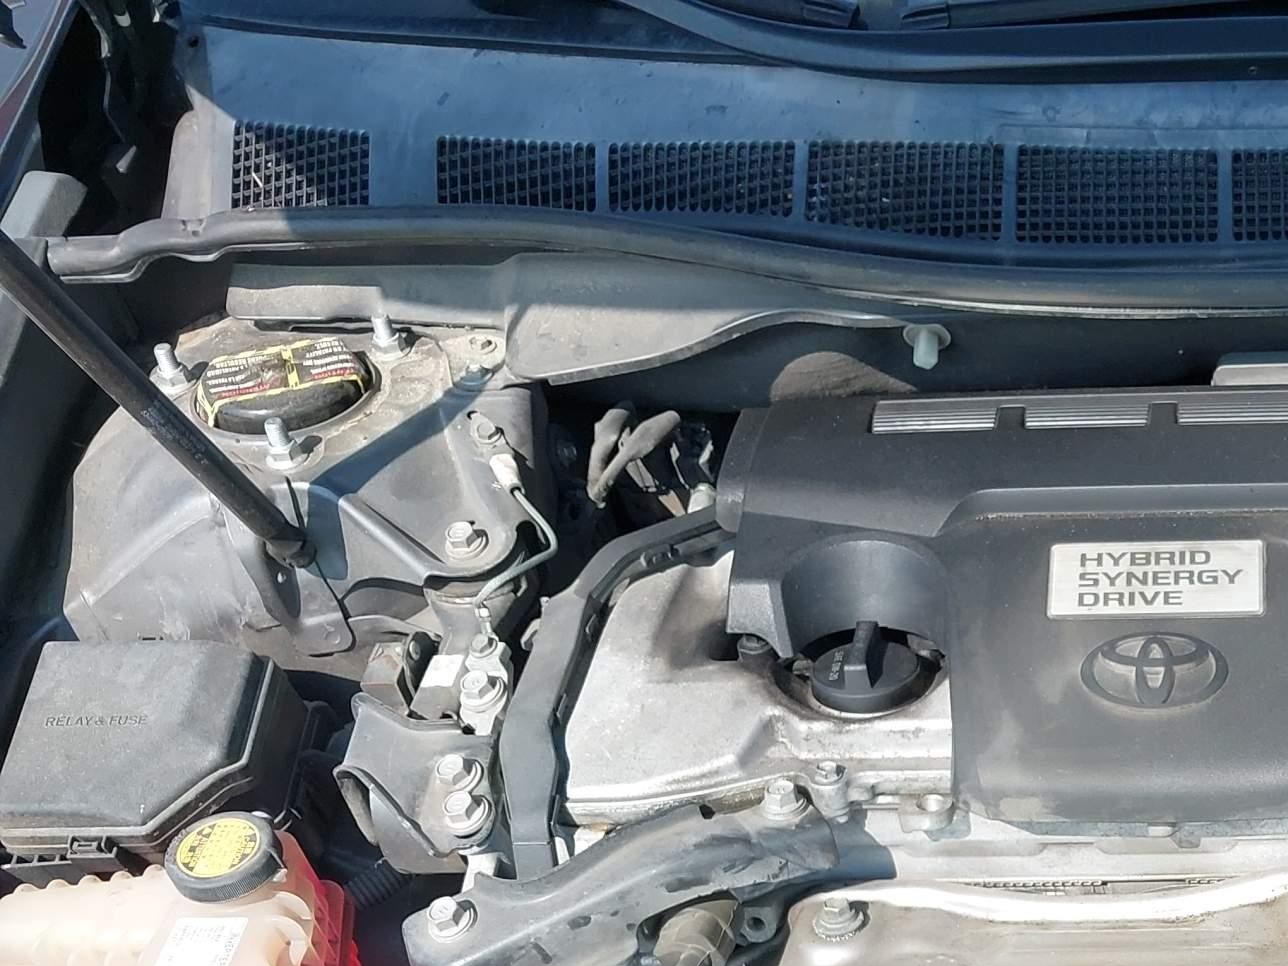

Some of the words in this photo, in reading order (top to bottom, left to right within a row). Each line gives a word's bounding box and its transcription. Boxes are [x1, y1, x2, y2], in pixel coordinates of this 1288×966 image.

[1080, 550, 1211, 567] HYBRID
[1078, 569, 1243, 588] SYNERGY
[1077, 591, 1183, 607] DRIVE
[45, 716, 93, 727] RELAY
[95, 717, 104, 726] &
[109, 715, 148, 726] FUSE
